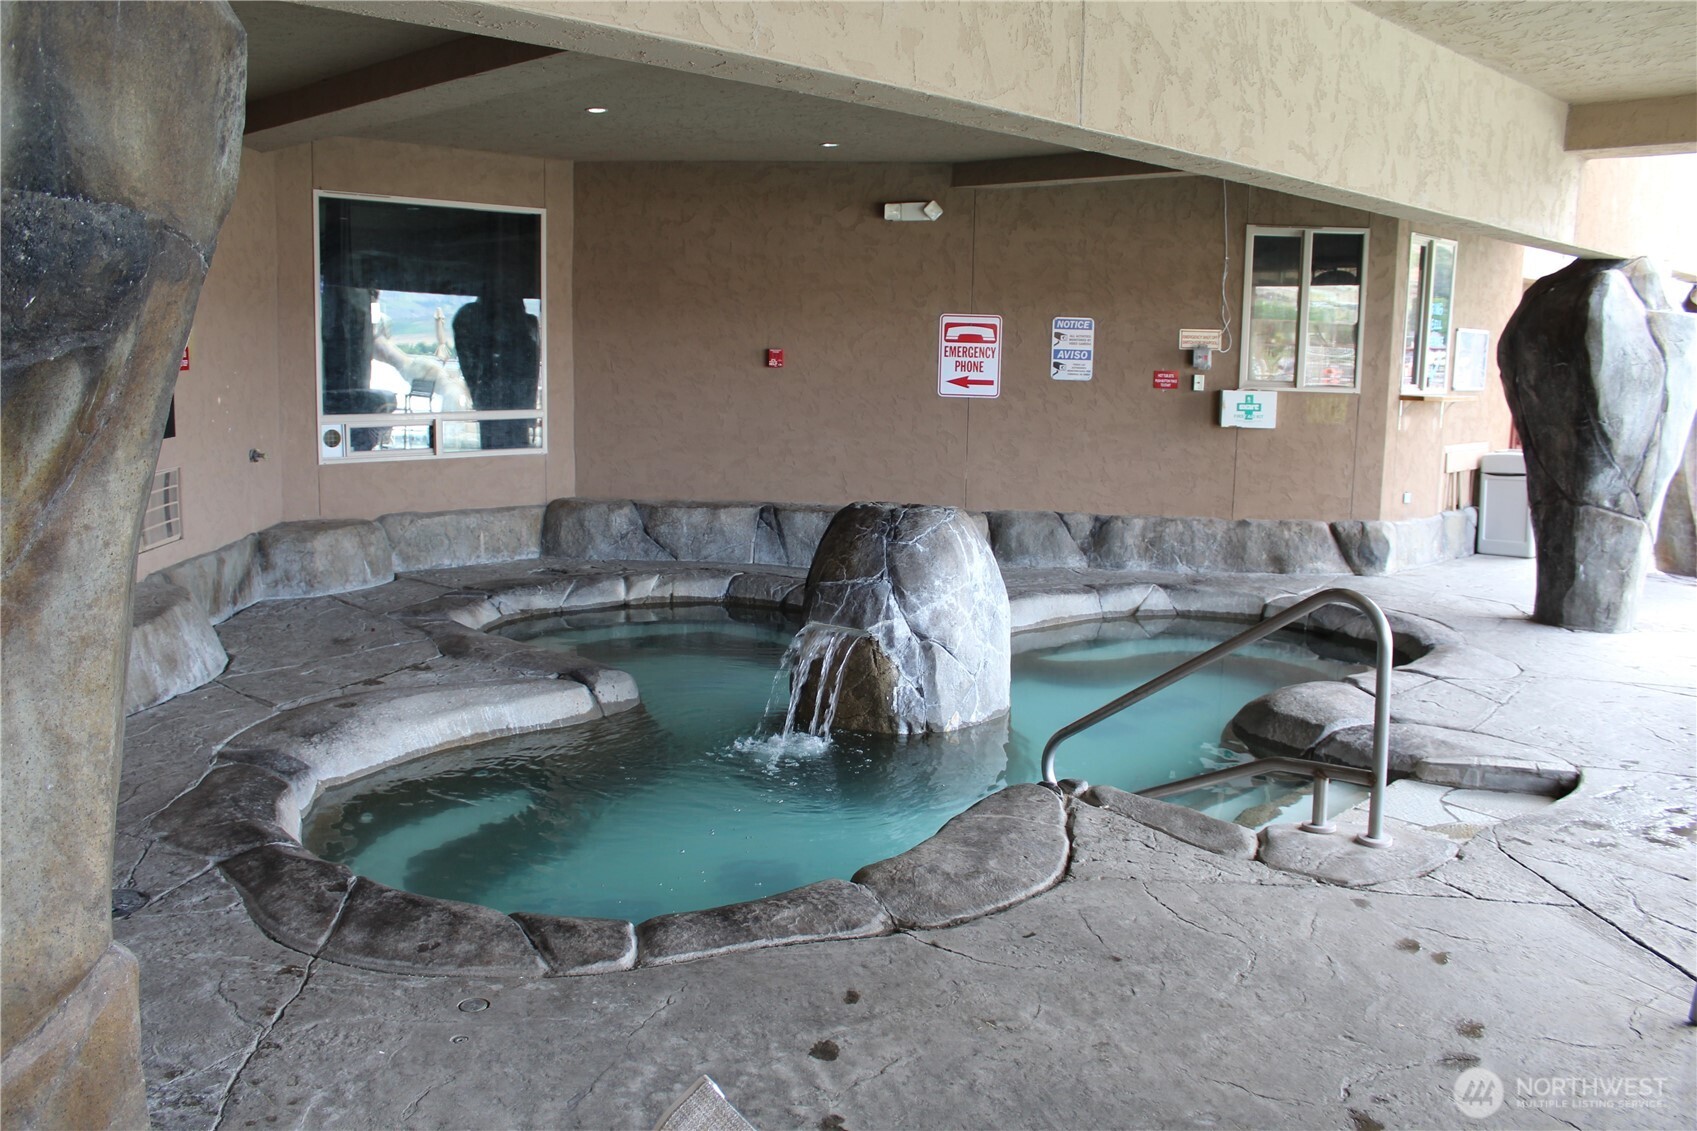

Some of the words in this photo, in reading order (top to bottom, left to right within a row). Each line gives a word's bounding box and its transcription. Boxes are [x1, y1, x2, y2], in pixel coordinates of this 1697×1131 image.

[1056, 320, 1090, 328] NOTICE
[944, 346, 996, 359] EMERGENCY
[1057, 350, 1088, 359] AVISO
[955, 360, 984, 372] PHONE
